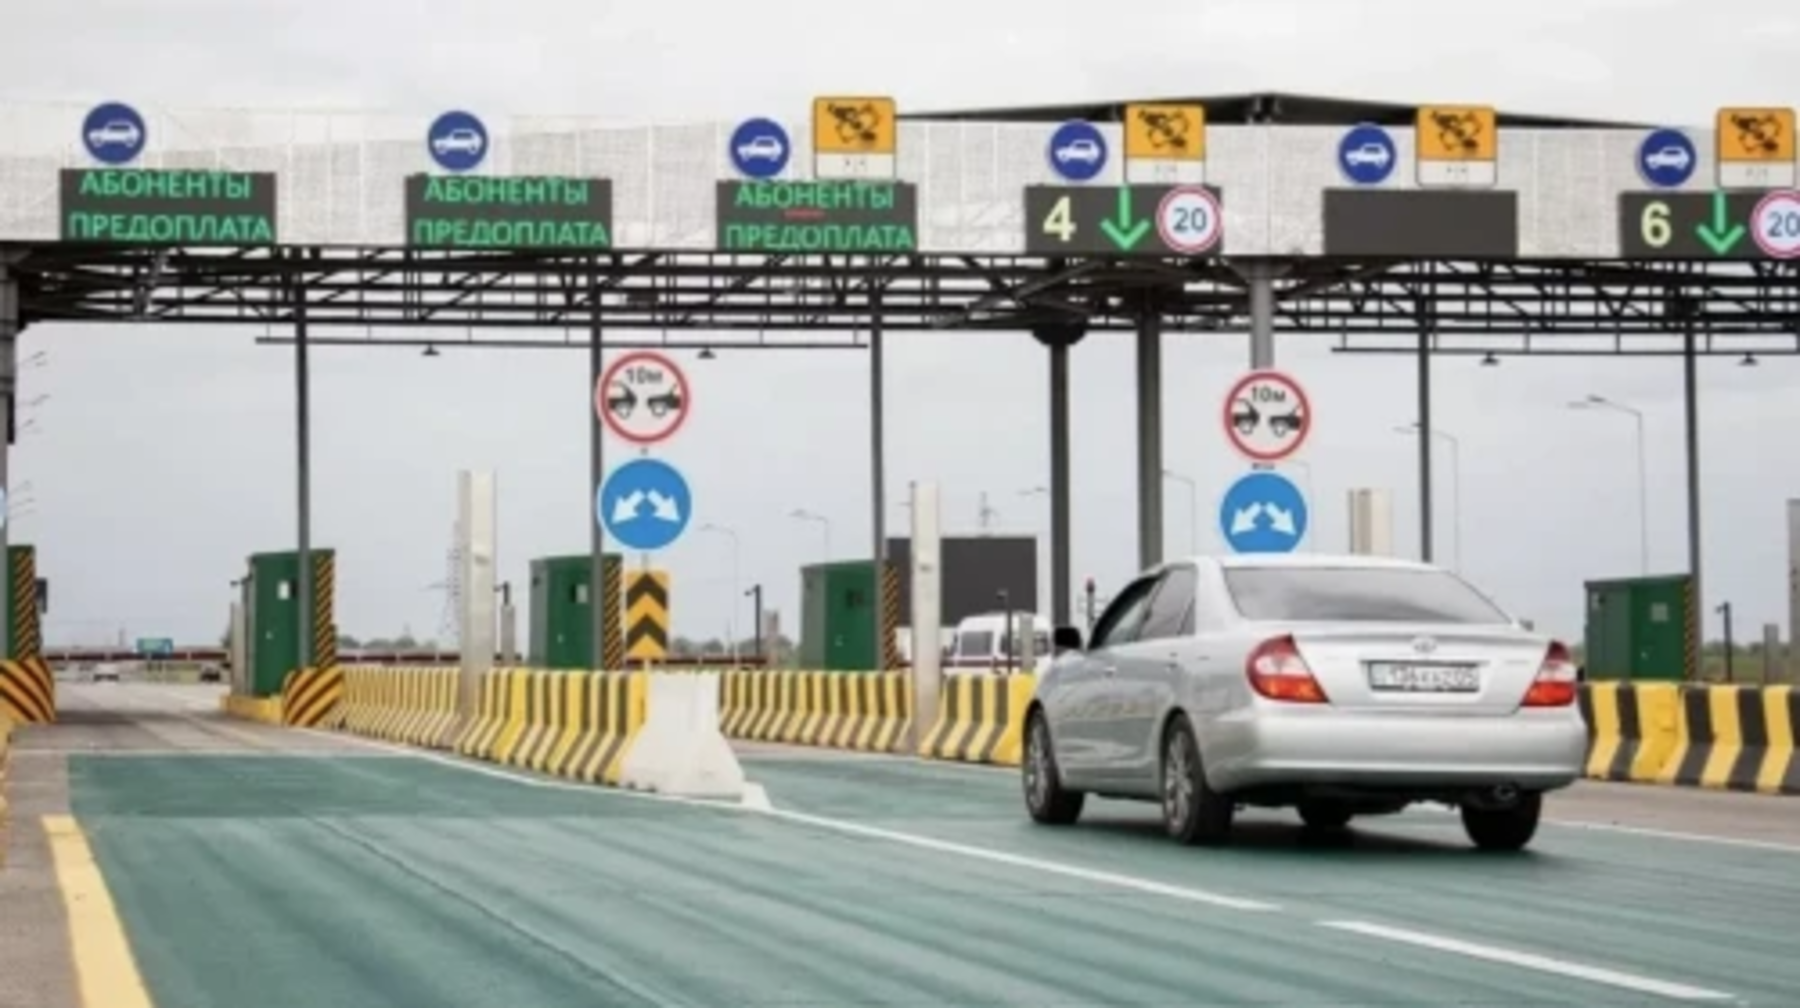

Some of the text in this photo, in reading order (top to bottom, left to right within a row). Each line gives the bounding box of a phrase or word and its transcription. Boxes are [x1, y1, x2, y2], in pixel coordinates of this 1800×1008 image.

[79, 171, 250, 198] АБОНЕНТЫ
[424, 177, 588, 204] АБОНЕНТЫ
[735, 182, 894, 208] АБОНЕНТЫ
[68, 212, 272, 241] ПРЕДОПЛАТА
[413, 219, 608, 246] ПРЕДОПЛАТА
[1043, 196, 1077, 242] 4
[1172, 207, 1208, 233] 20
[1641, 201, 1672, 247] 6
[1767, 211, 1800, 238] 20
[726, 225, 914, 250] ПРЕДОПЛАТА
